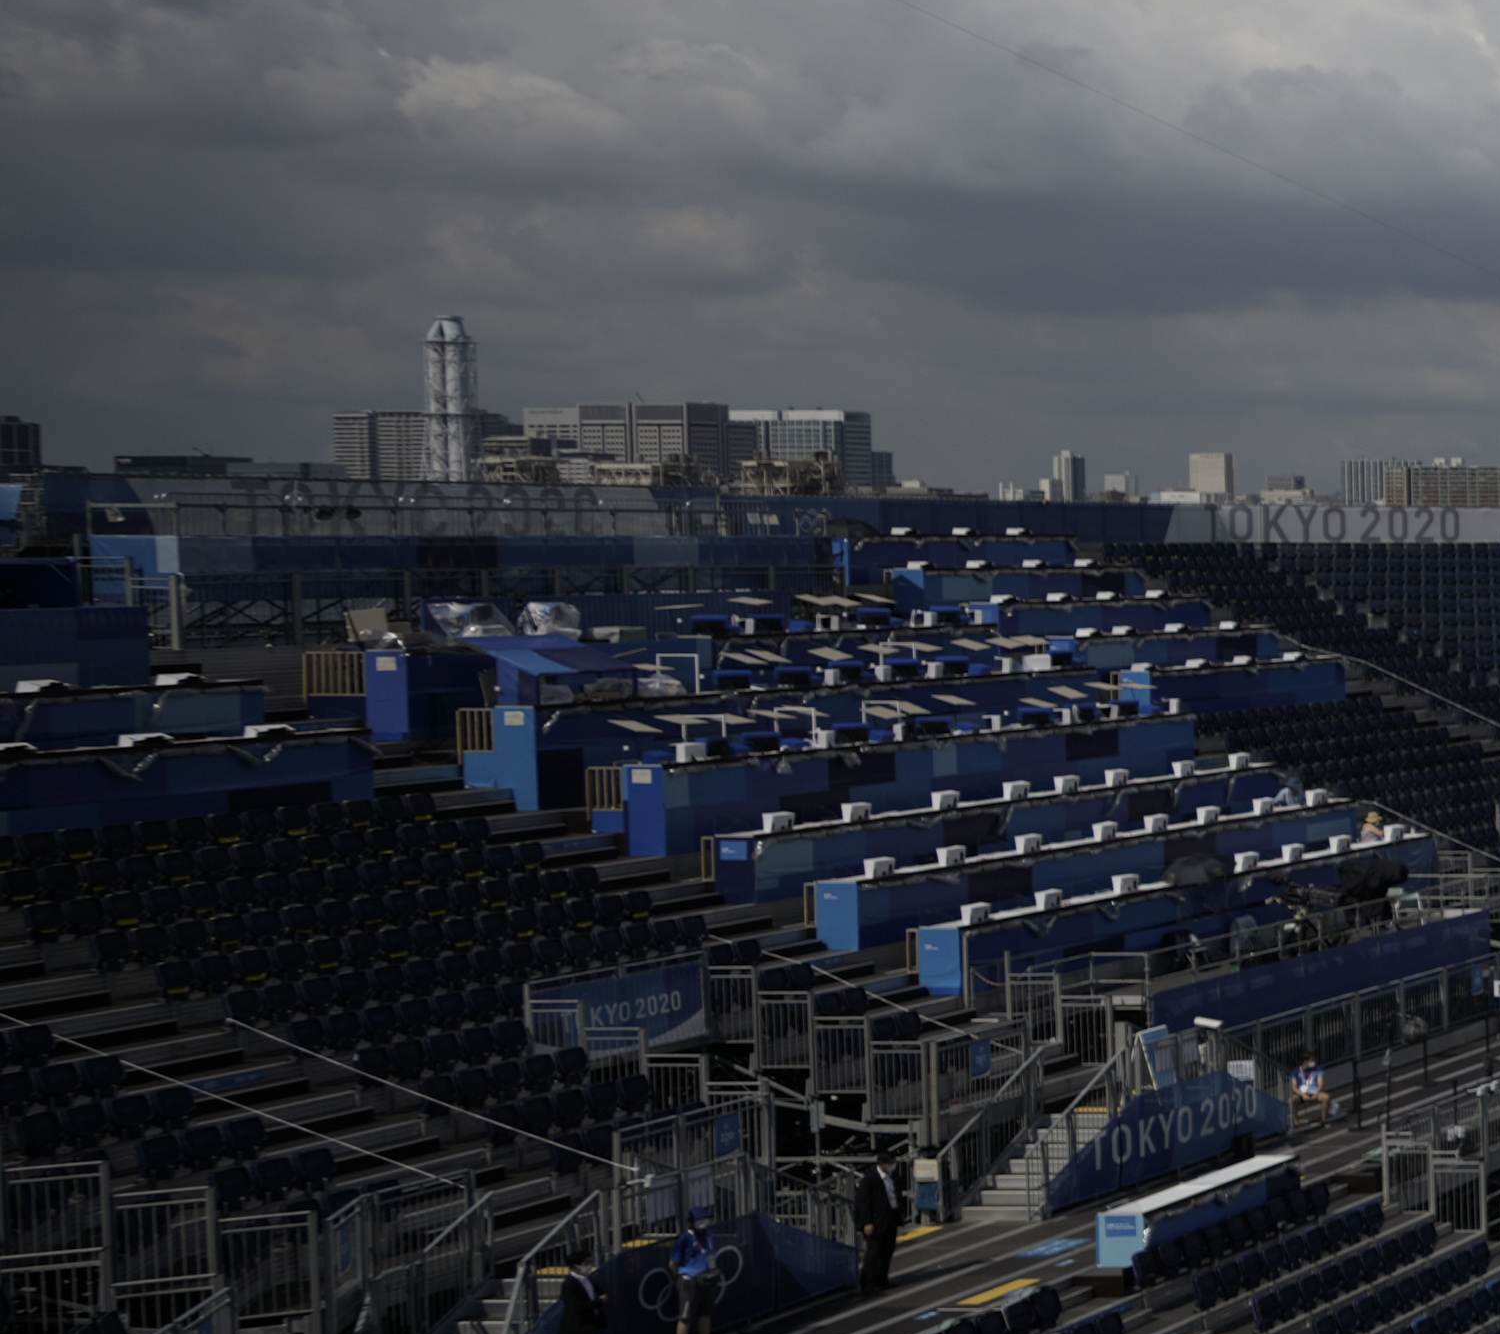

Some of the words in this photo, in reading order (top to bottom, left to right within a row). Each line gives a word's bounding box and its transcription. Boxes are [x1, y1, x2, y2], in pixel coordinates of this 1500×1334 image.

[1204, 504, 1346, 543] TOKYO
[1360, 504, 1460, 543] 2020
[634, 991, 682, 1019] 2020
[1092, 1104, 1193, 1171] TOKYO
[1199, 1082, 1258, 1137] 2020
